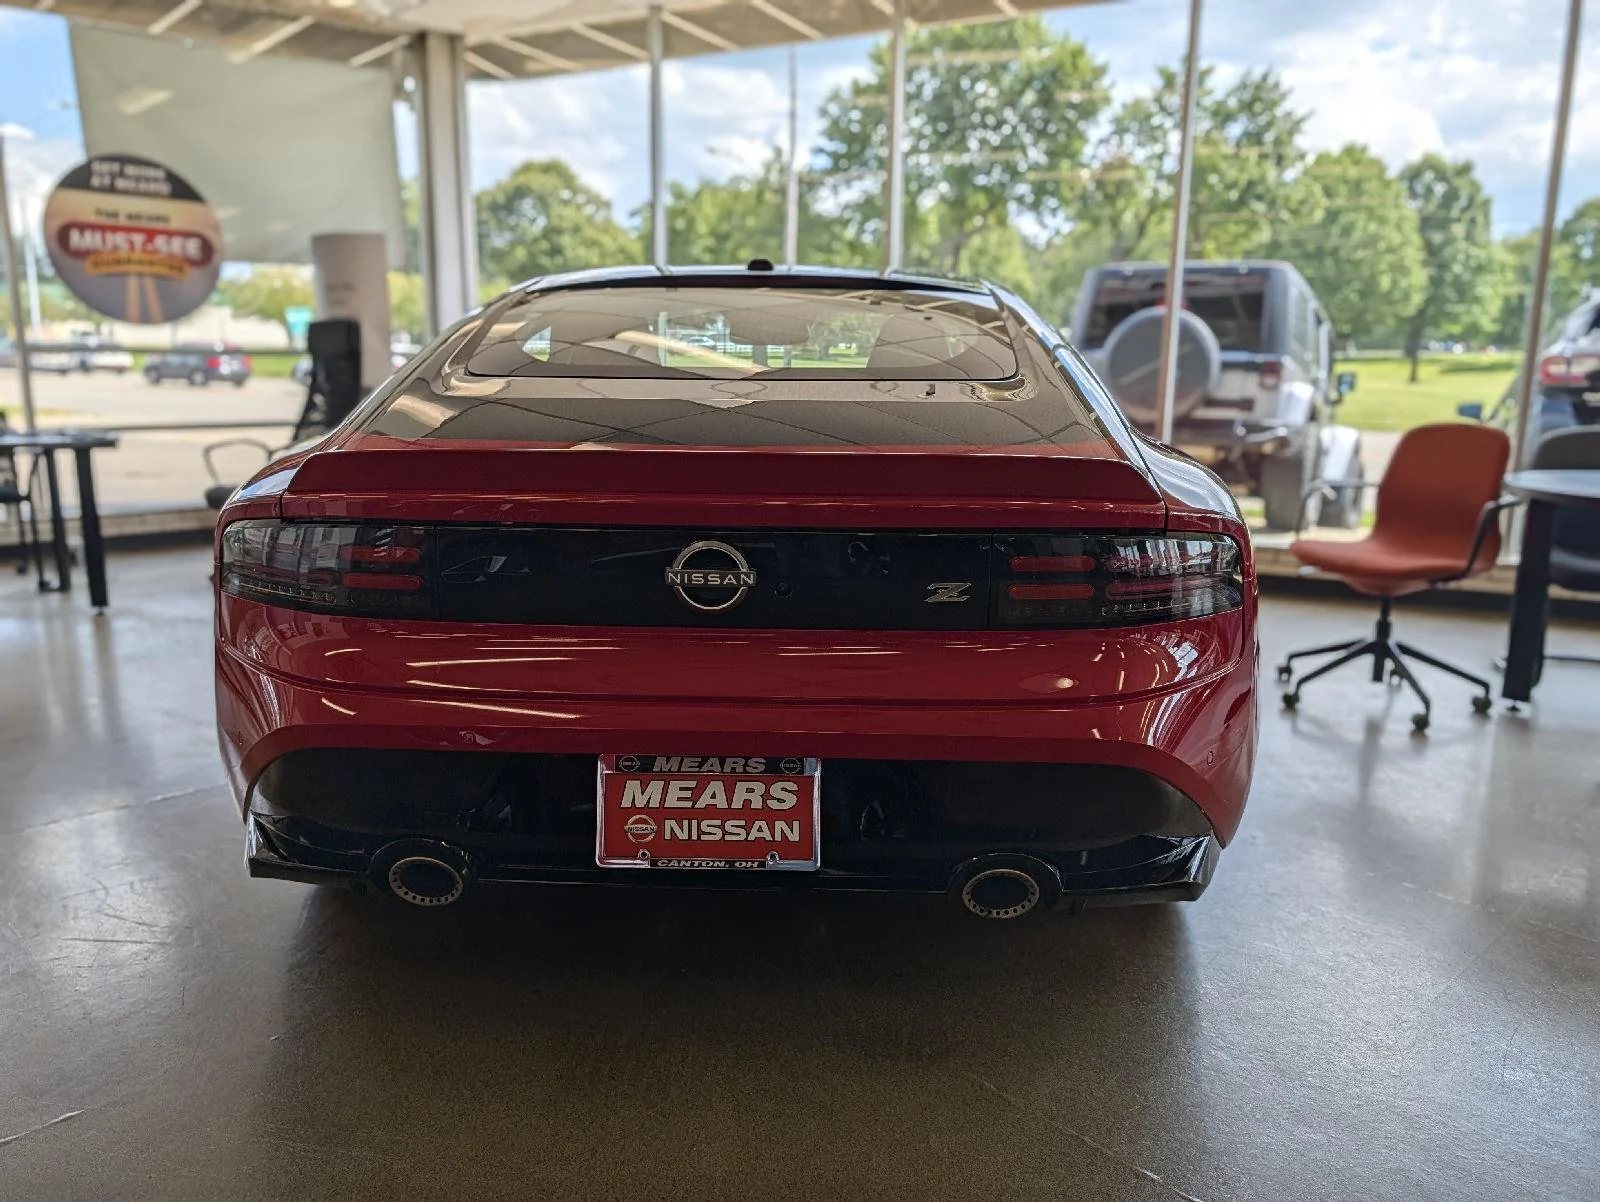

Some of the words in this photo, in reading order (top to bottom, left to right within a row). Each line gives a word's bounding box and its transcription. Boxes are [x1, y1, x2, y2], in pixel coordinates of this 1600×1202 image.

[69, 228, 202, 260] MUST-SEE
[668, 572, 755, 585] NISSAN
[924, 582, 972, 603] Z
[653, 757, 767, 773] MEARS
[621, 780, 799, 810] MEARS
[664, 819, 800, 842] NISSAN
